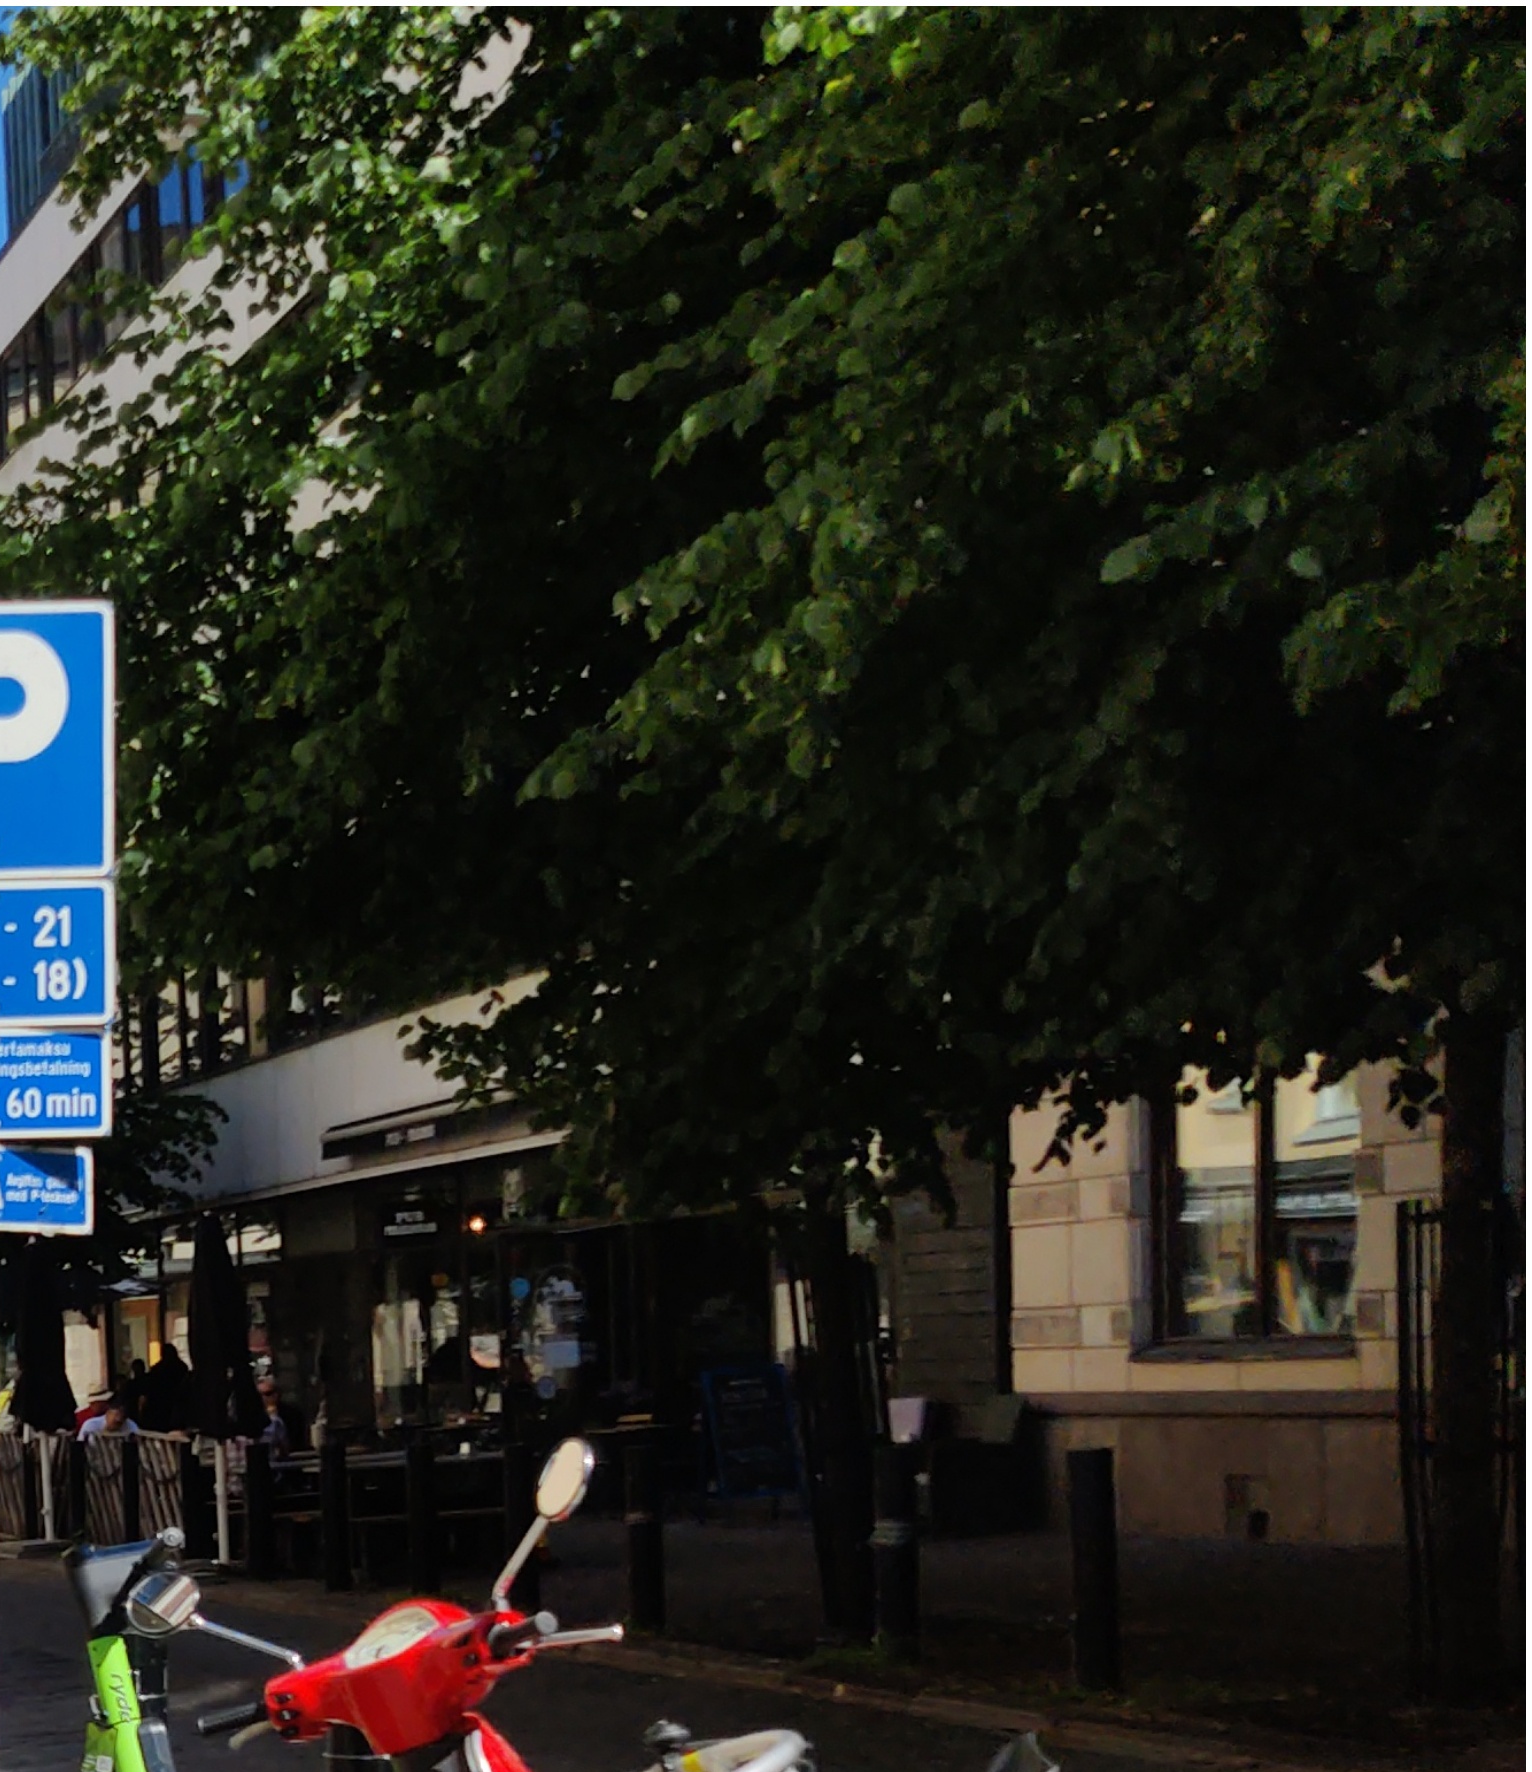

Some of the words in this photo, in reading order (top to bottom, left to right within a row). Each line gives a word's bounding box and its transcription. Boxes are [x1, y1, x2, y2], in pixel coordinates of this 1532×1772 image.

[33, 905, 72, 948] 21
[33, 956, 88, 1001] 18)
[5, 1086, 43, 1119] 60
[46, 1087, 97, 1119] min
[108, 1673, 132, 1722] ryde
